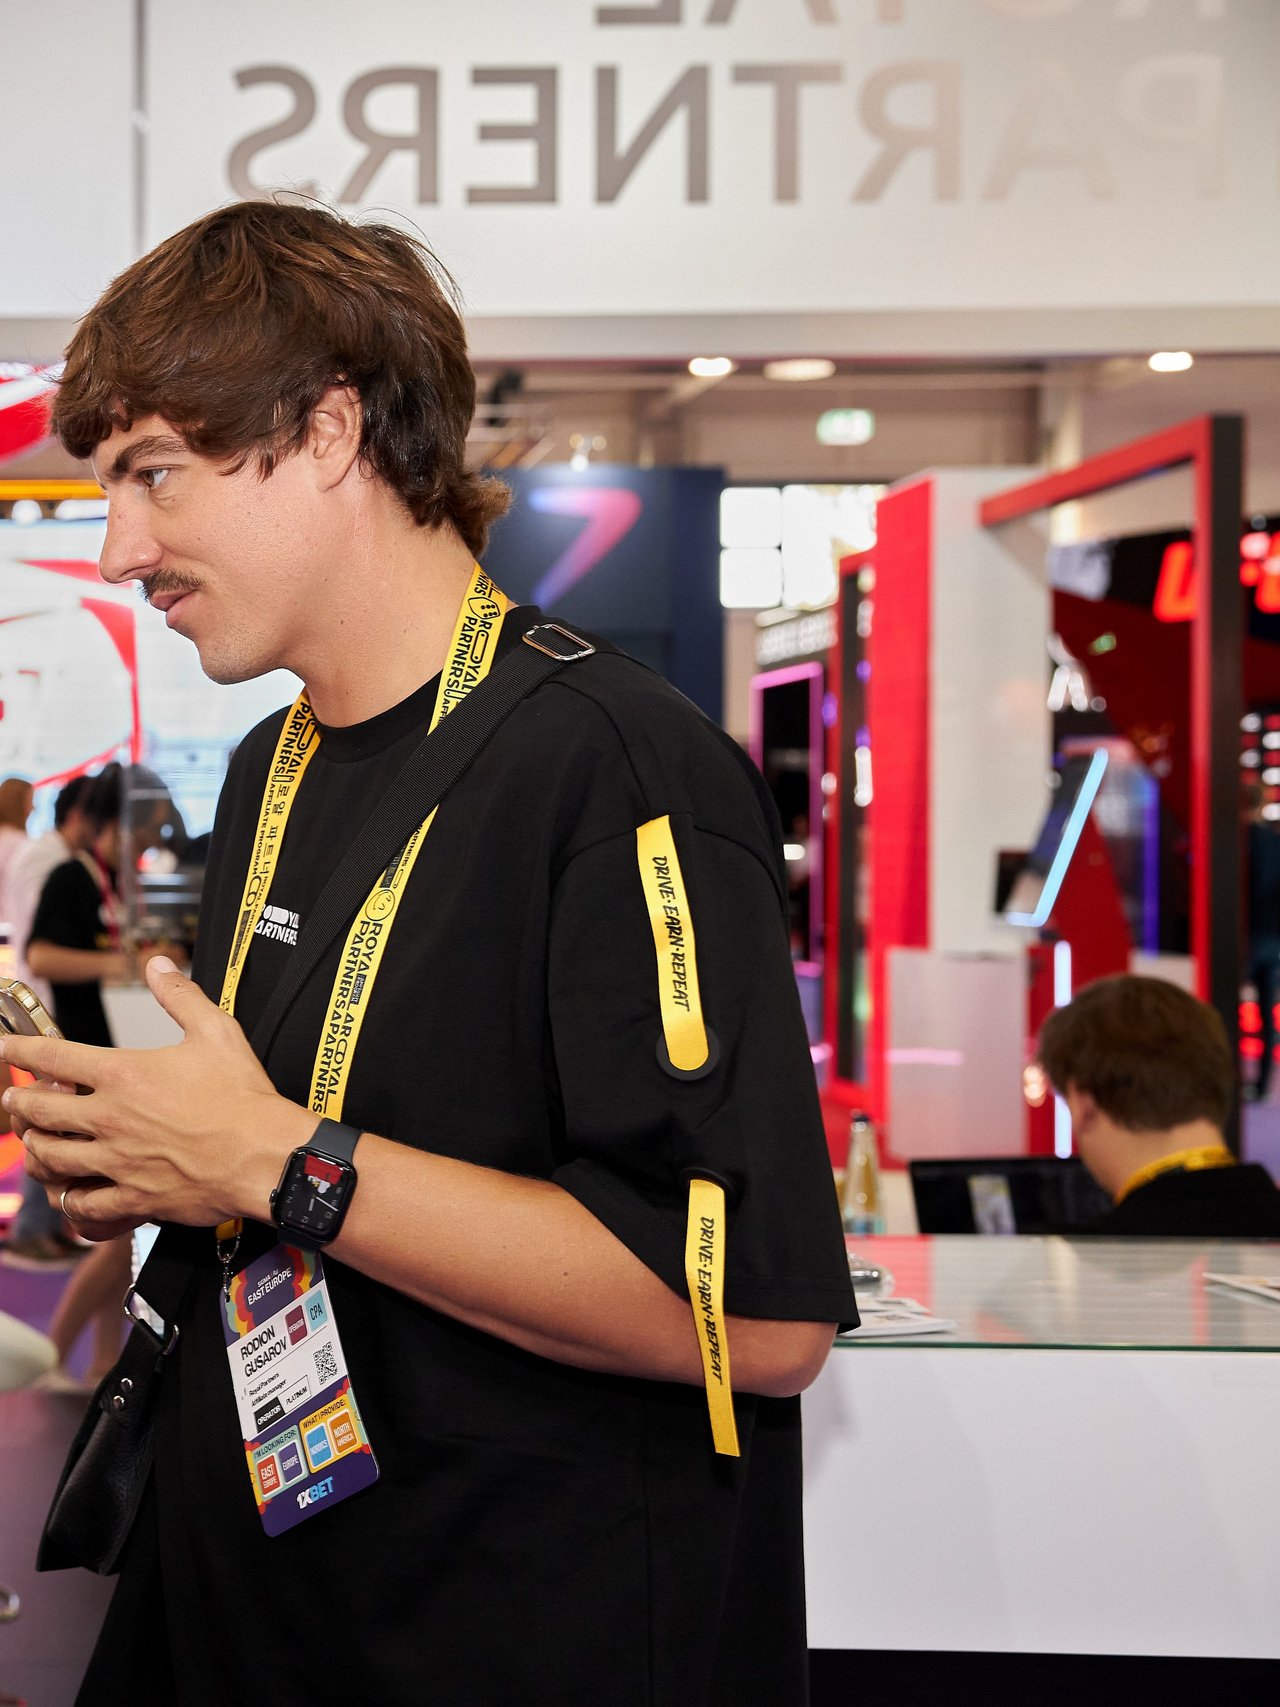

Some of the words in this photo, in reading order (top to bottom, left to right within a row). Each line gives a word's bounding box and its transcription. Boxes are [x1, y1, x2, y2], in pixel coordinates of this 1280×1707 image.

[446, 615, 478, 690] PARTNERS
[274, 701, 312, 775] PARTNERS
[285, 712, 317, 775] OYAL
[260, 783, 275, 828] AFFILIATE
[251, 830, 264, 874] PROGRAM
[254, 920, 298, 946] ARTNERS
[247, 1286, 265, 1306] EAST
[264, 1267, 292, 1293] EUROPE
[309, 1302, 323, 1321] CPA
[240, 1325, 276, 1360] RODION
[244, 1336, 287, 1377] GUSAROV
[267, 1379, 287, 1396] manager
[285, 1385, 308, 1405] PLATINUM
[257, 1404, 281, 1425] OPERATOR
[303, 1413, 319, 1428] WHAT
[321, 1398, 346, 1418] PROVIDE:
[333, 1421, 351, 1437] NORTH
[261, 1436, 284, 1455] LOOKING
[260, 1463, 275, 1480] EAST
[283, 1456, 299, 1471] EUROPE
[296, 1476, 334, 1510] 1XBET
